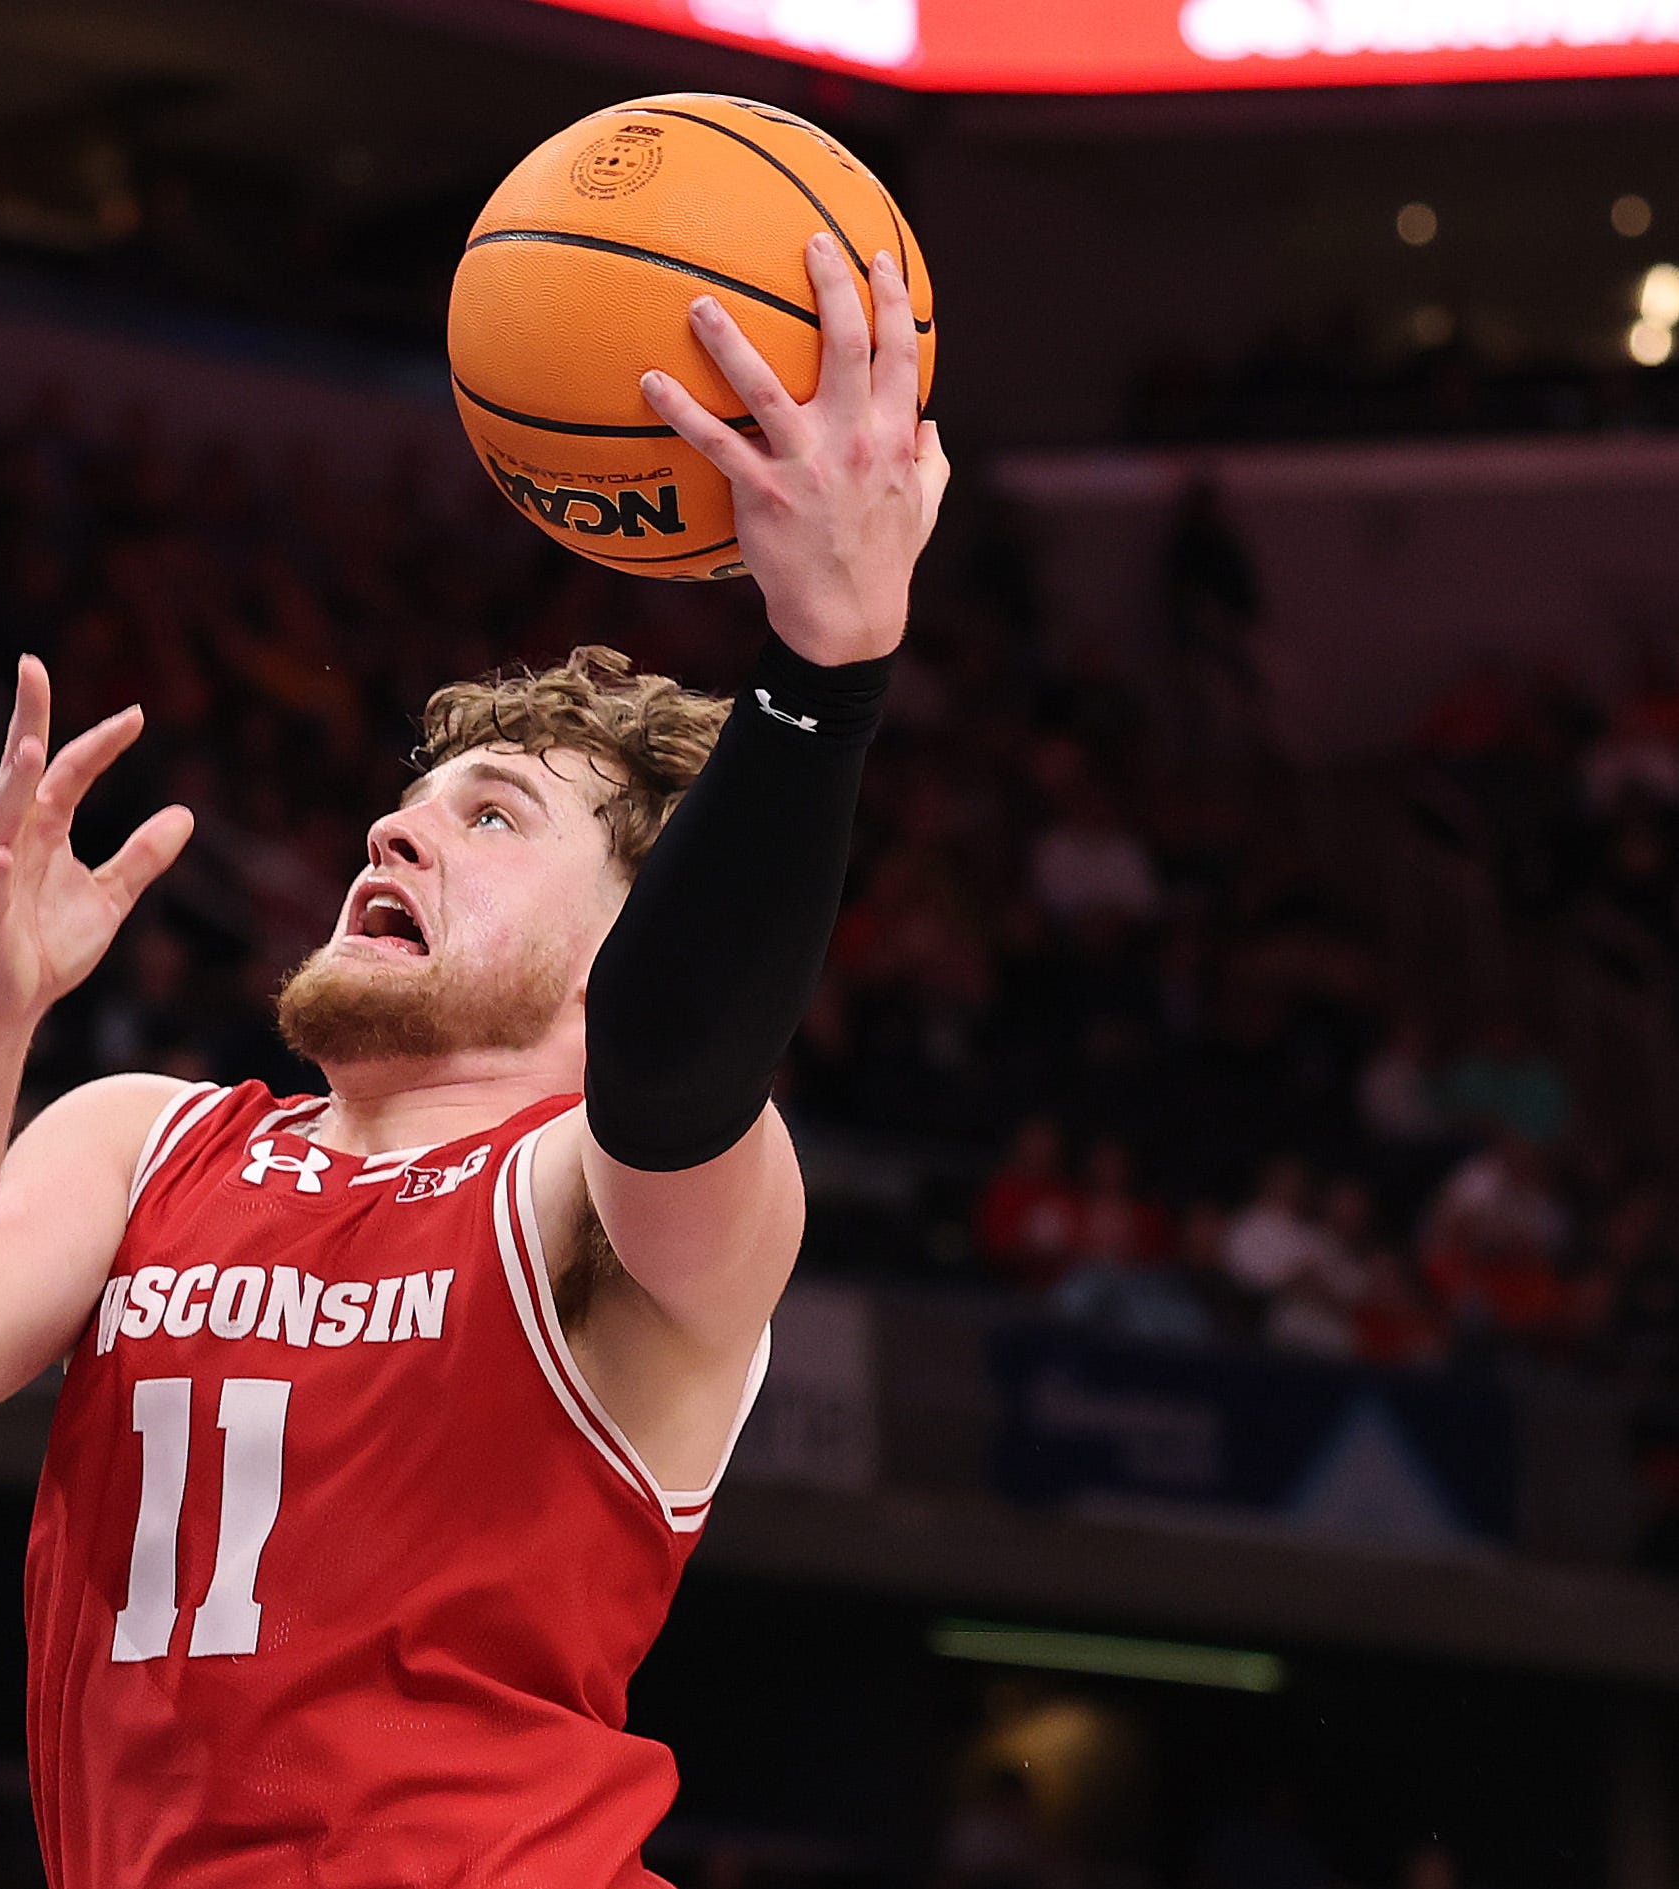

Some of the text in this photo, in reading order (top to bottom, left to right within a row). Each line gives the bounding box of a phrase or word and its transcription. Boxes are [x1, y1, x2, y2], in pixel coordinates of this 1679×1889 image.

[485, 452, 687, 538] NCAA
[577, 466, 674, 484] OFFICIAL
[96, 1262, 455, 1357] WSCONSIN
[110, 1377, 292, 1663] 11
